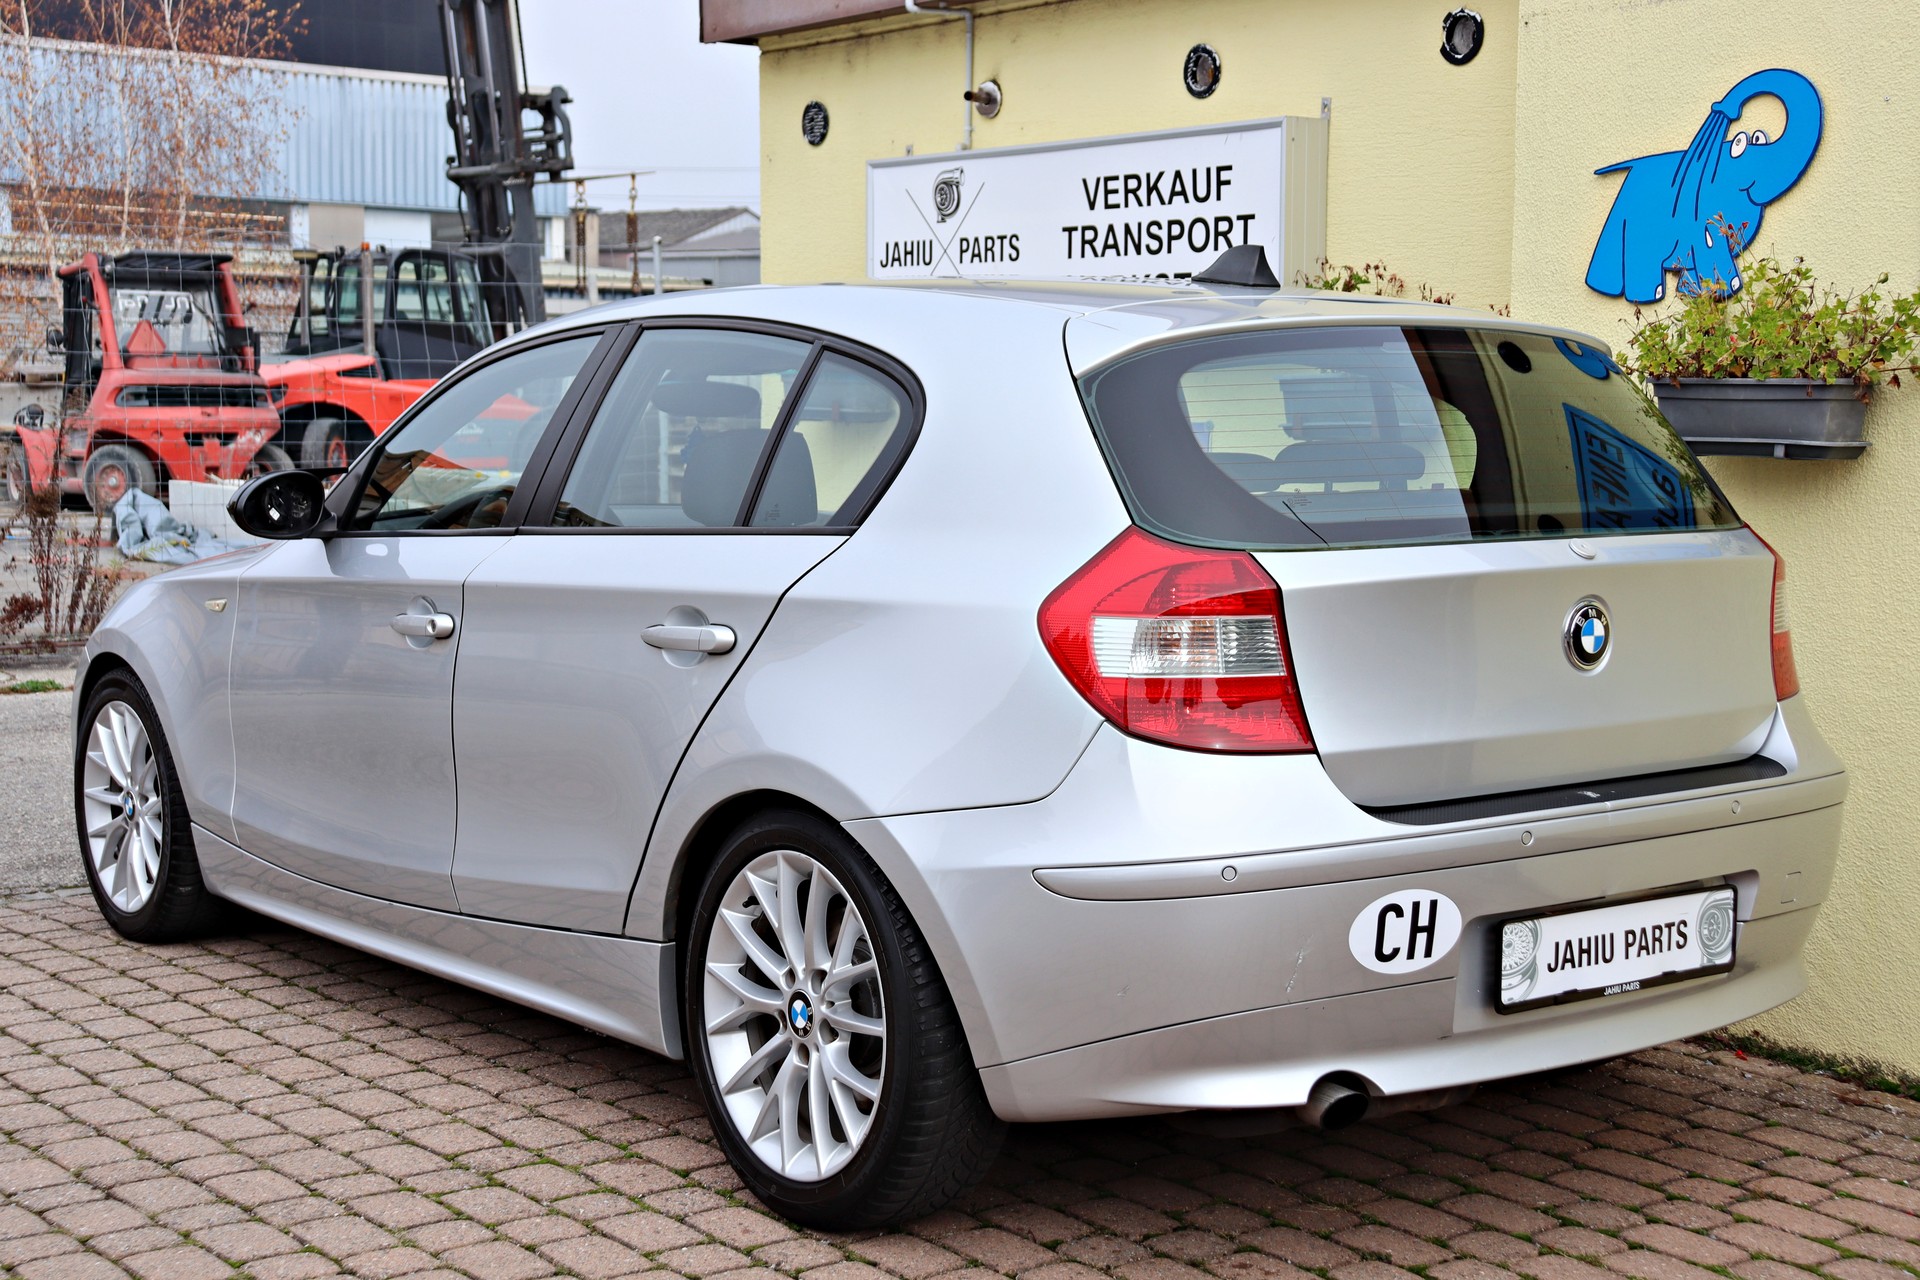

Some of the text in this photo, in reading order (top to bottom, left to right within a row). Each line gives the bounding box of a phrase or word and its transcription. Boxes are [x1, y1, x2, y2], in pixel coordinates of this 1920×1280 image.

[1082, 164, 1233, 211] VERKAUF
[880, 233, 1020, 268] JAHIU PARTS
[1062, 213, 1256, 259] TRANSPORT
[1576, 608, 1608, 627] BMW
[1374, 899, 1438, 963] CH
[1547, 919, 1689, 973] JAHIU PARTS
[1603, 981, 1640, 996] JAHIU PARTS
